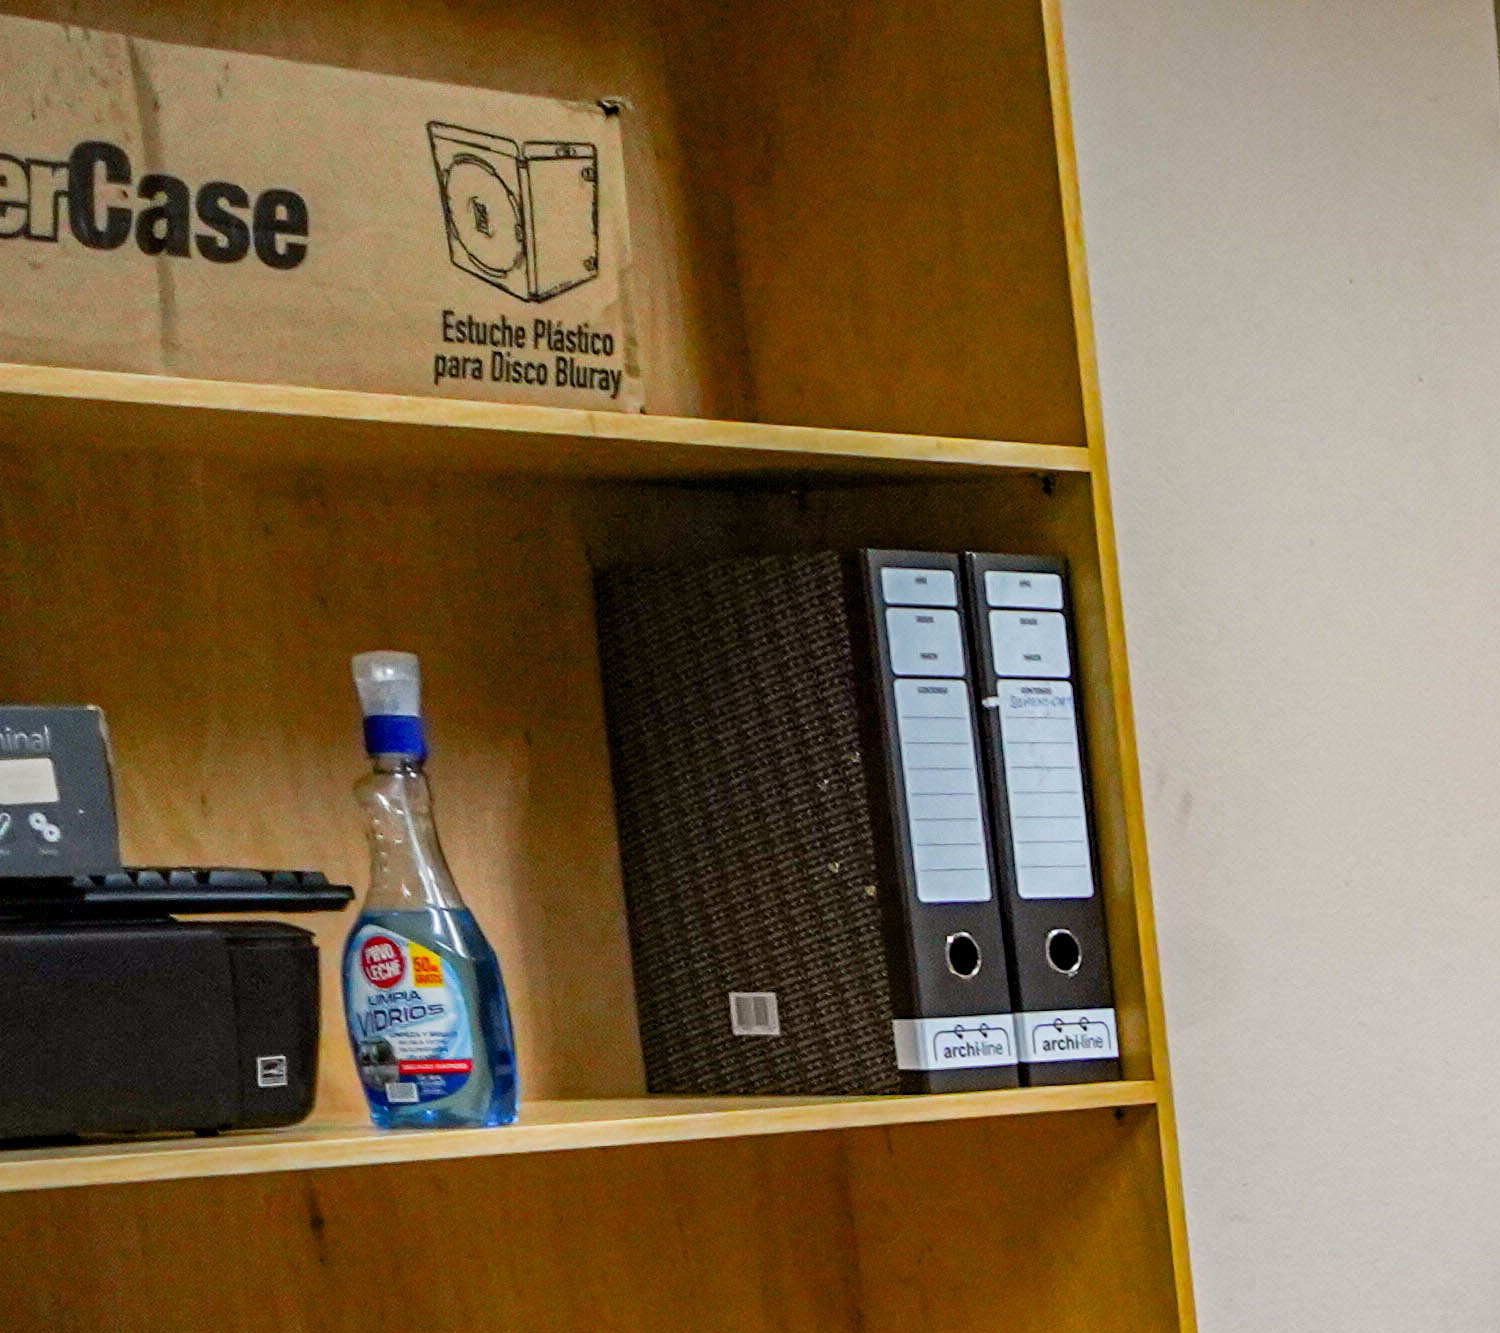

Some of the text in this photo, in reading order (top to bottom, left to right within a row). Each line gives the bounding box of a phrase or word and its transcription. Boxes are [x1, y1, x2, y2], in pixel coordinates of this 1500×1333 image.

[442, 309, 615, 357] Estuche Plástico
[433, 352, 623, 398] para Disco Bluray
[367, 990, 422, 1006] LIMPIA
[357, 1003, 445, 1036] VIDRIOS
